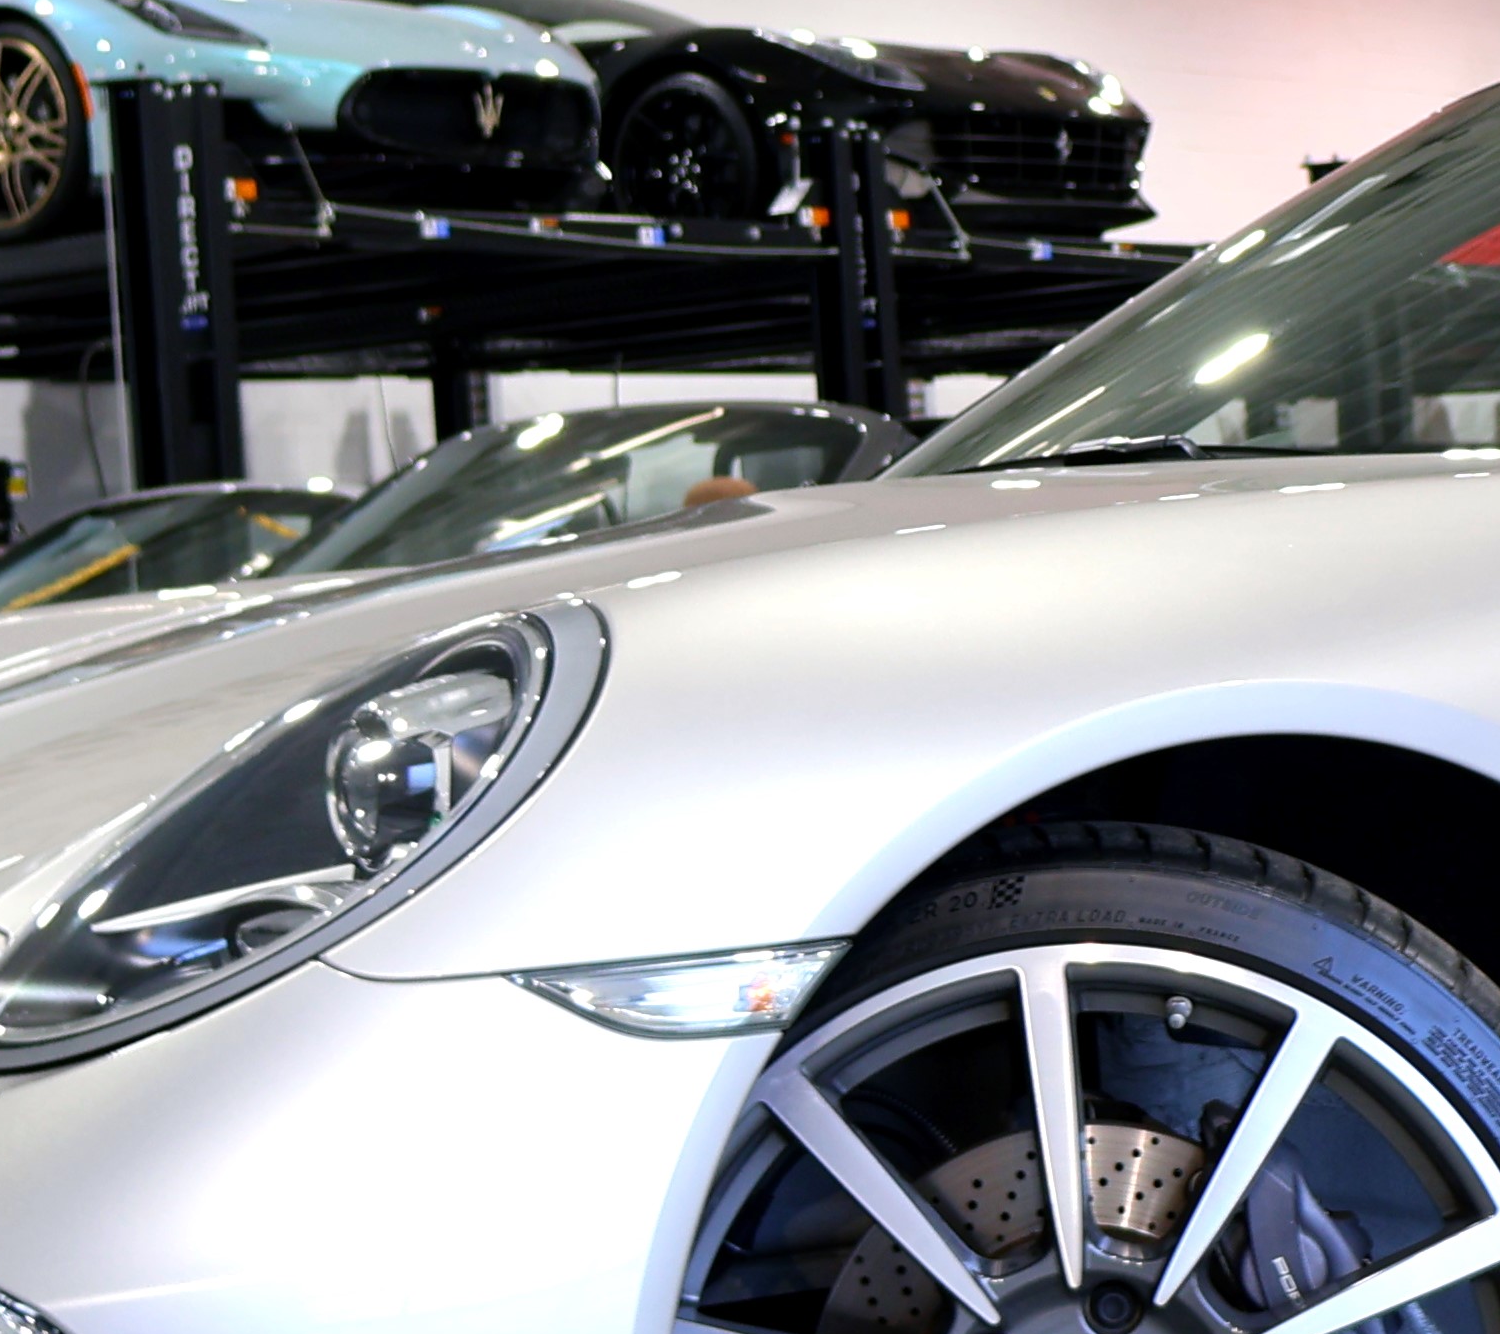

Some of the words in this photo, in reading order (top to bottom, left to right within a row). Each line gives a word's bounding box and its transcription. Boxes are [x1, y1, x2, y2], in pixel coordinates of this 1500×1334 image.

[173, 143, 199, 292] DIRECT
[944, 889, 980, 914] 20
[1009, 910, 1068, 930] EXTRA
[1076, 908, 1127, 923] LOAD
